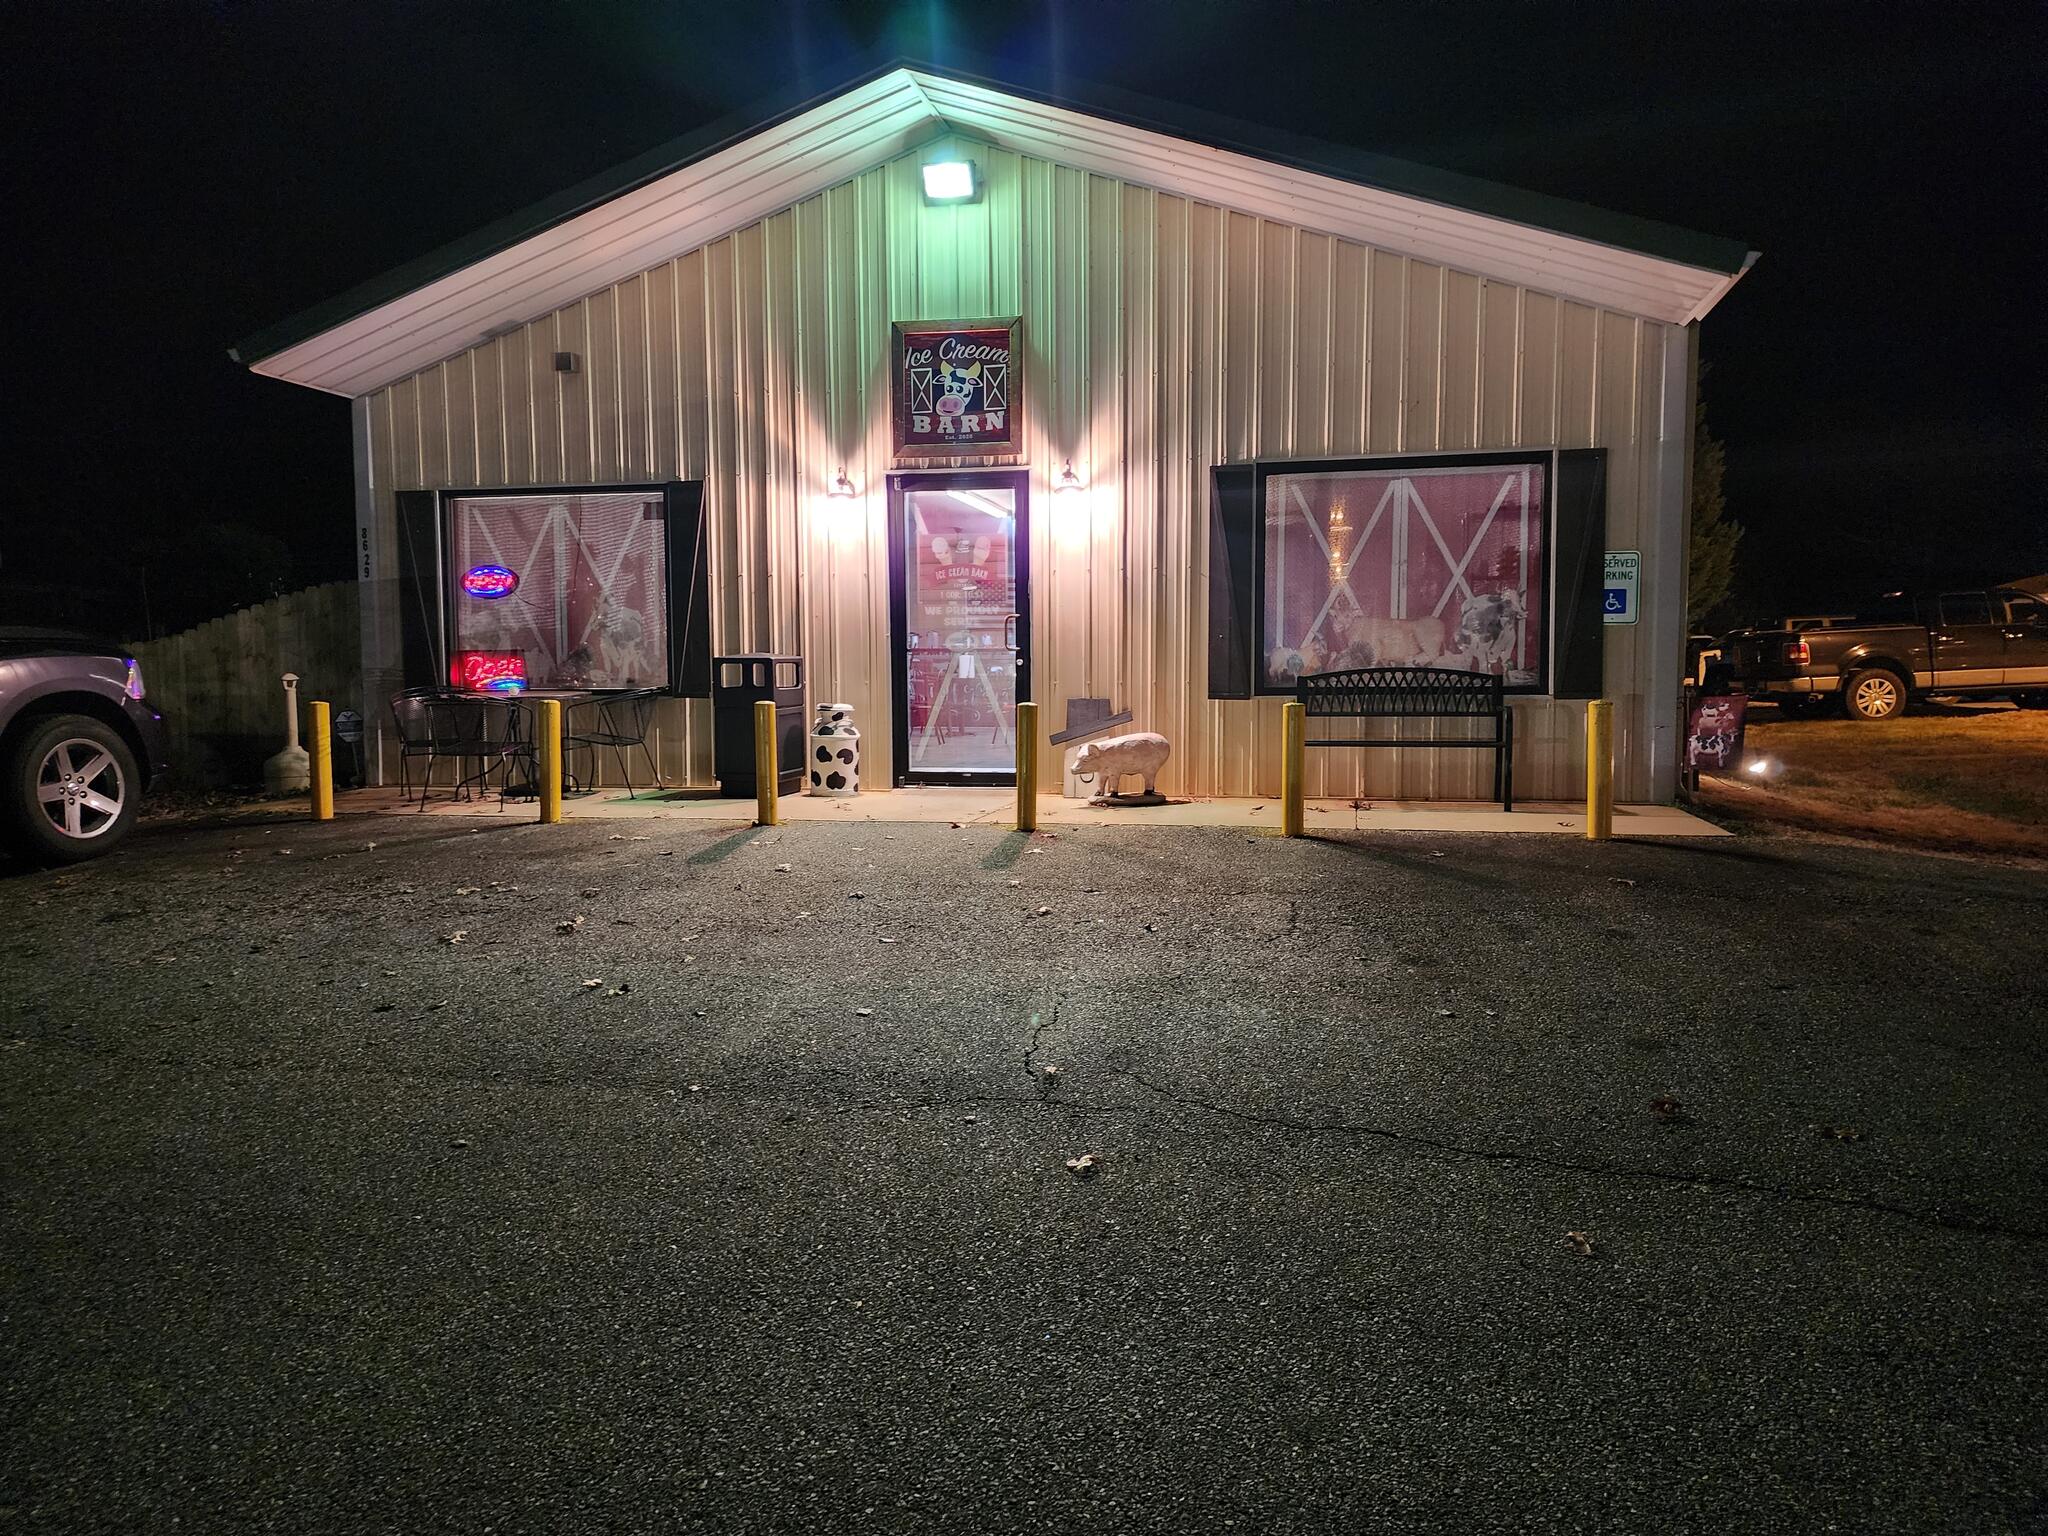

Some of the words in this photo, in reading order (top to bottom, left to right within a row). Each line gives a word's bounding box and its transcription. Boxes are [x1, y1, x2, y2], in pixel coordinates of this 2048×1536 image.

[905, 347, 933, 369] Ice
[939, 338, 1010, 364] Cream
[913, 411, 1005, 434] BARN
[361, 527, 370, 578] 8629
[1603, 558, 1637, 568] SERVED
[1605, 571, 1633, 580] RKING
